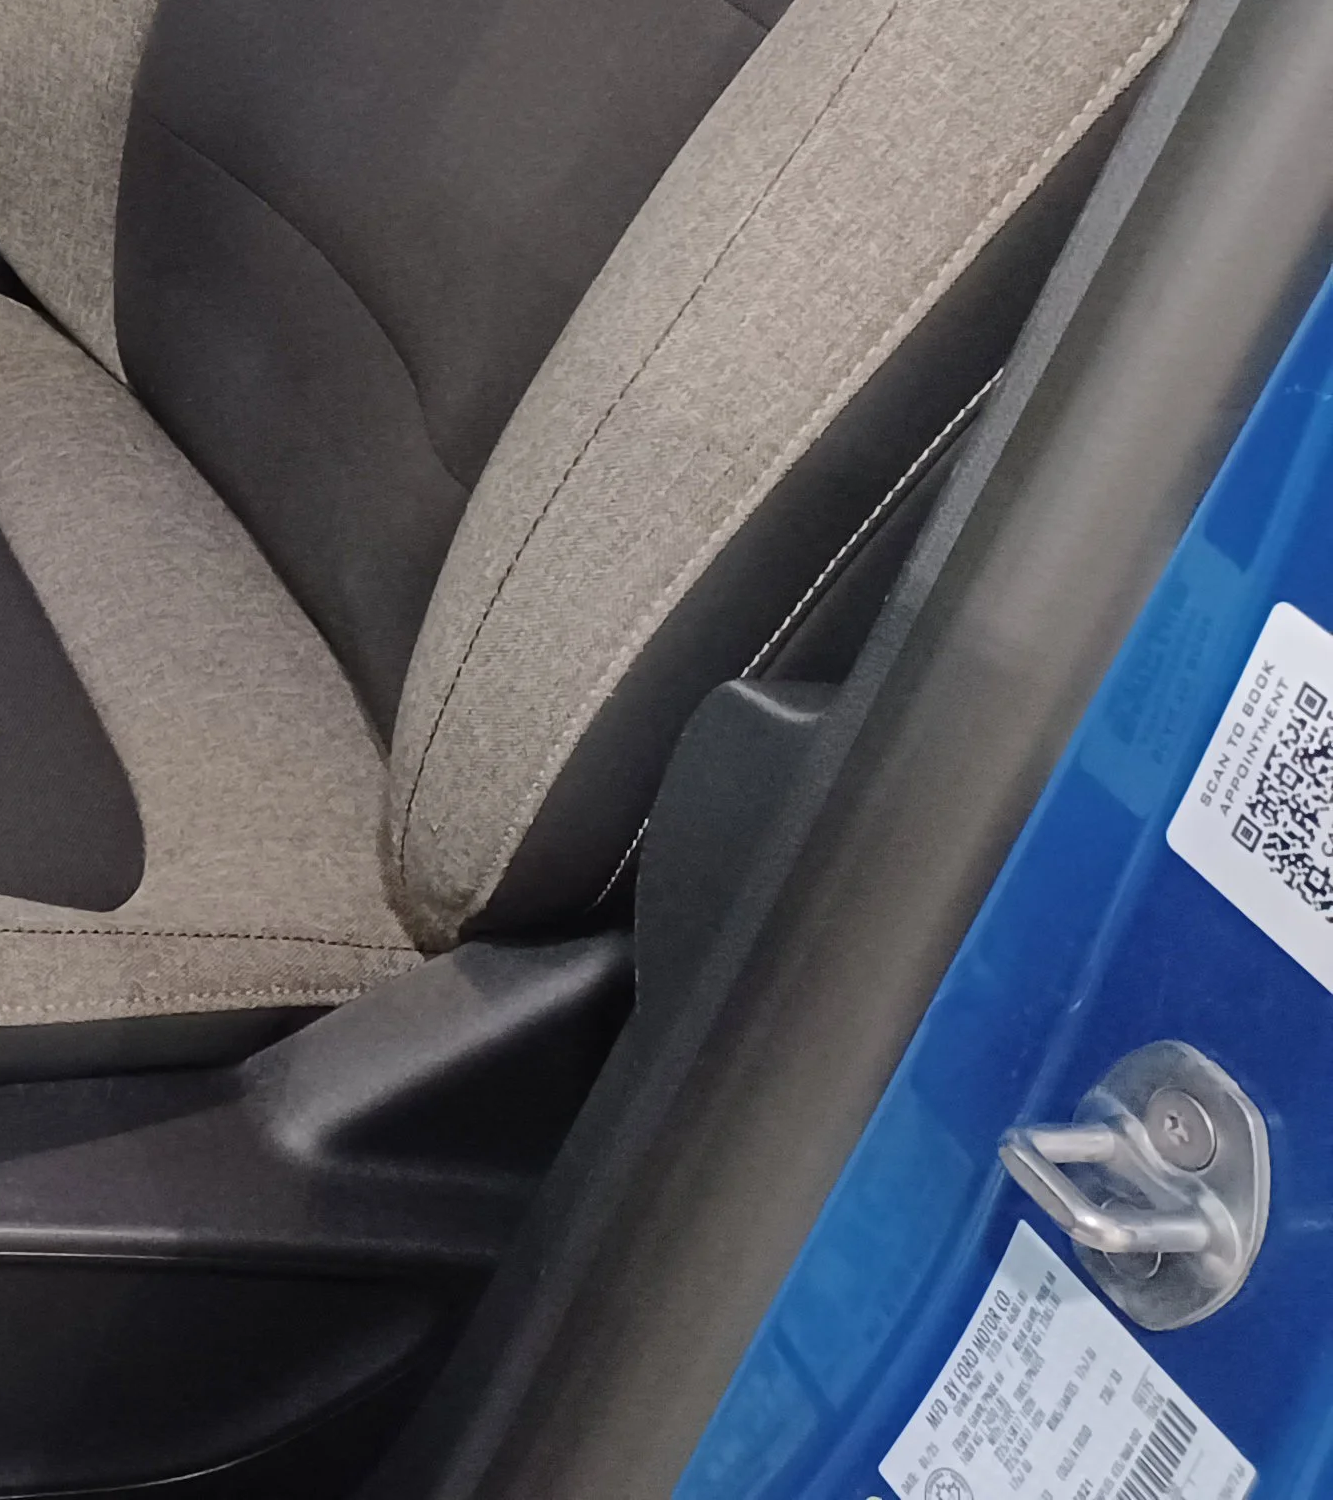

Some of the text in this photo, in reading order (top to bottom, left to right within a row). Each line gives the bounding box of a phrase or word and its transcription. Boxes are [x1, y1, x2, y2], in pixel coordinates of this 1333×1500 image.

[1200, 659, 1275, 807] SCAN TO BOOK
[1220, 676, 1289, 817] APPOINTMENT
[969, 1306, 1003, 1356] MOTOR
[942, 1377, 961, 1402] BY
[951, 1345, 980, 1385] FORD
